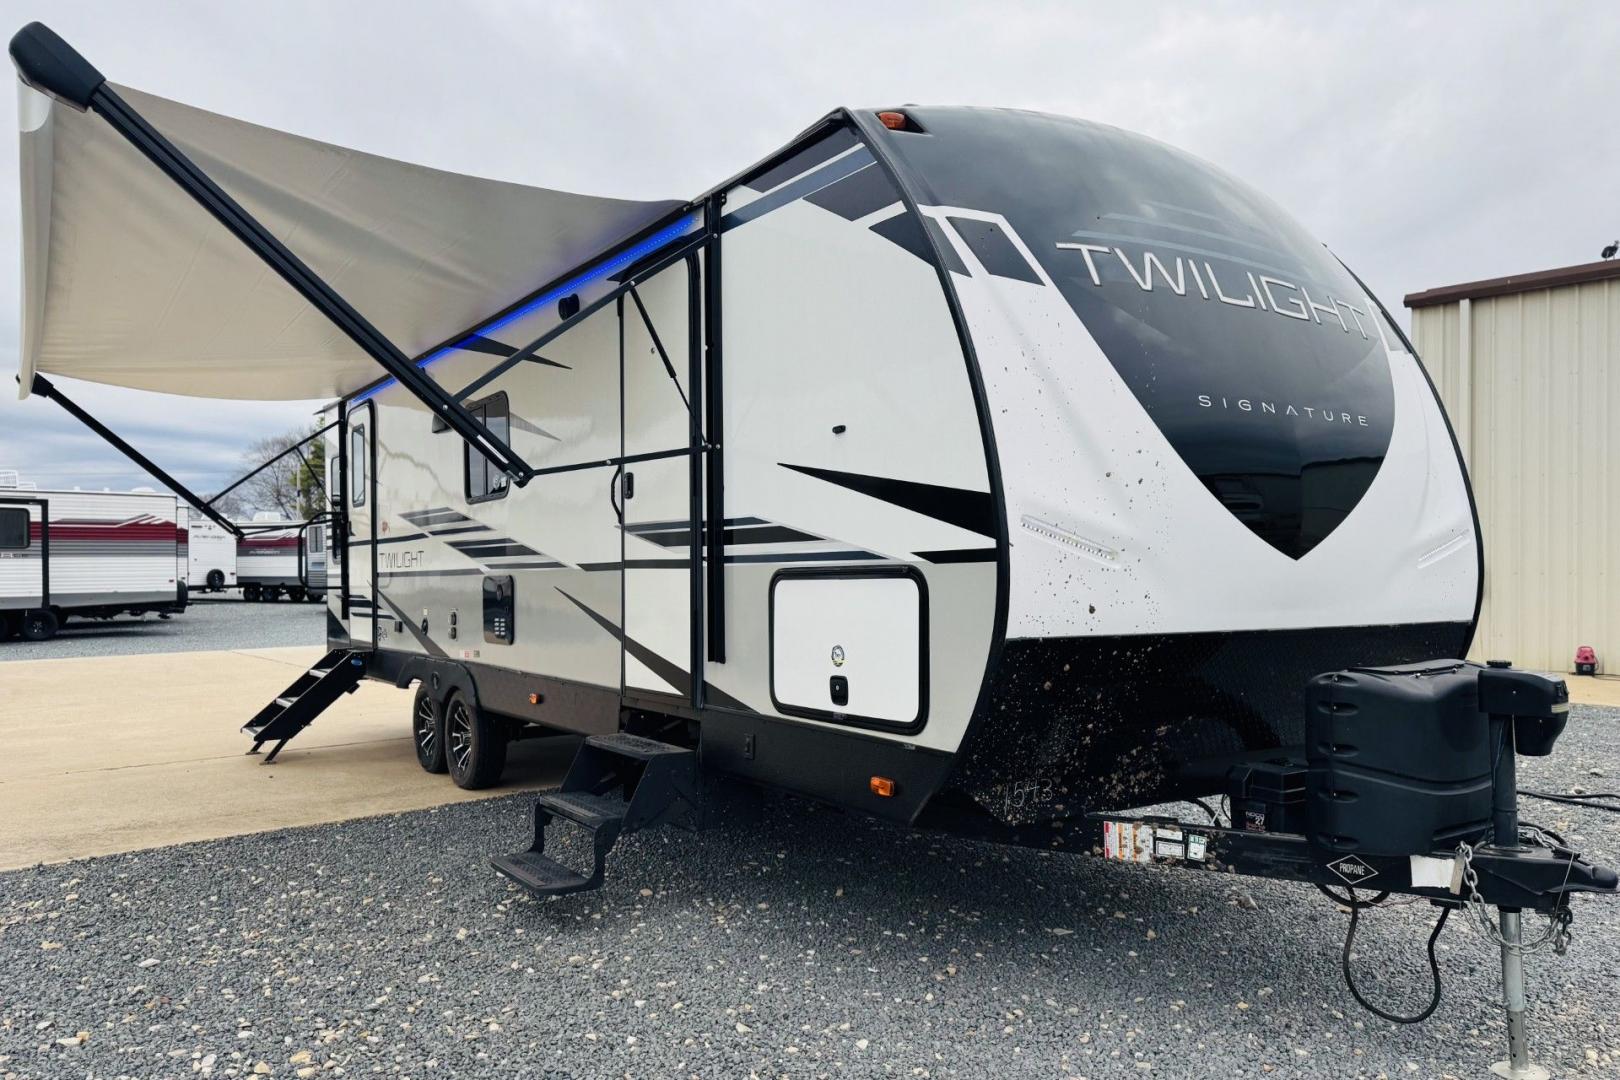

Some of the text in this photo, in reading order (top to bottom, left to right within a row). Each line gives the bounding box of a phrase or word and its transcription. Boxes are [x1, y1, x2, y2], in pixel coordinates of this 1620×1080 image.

[1056, 242, 1368, 340] TWILIGHT
[1198, 395, 1368, 426] SIGNATURE
[379, 550, 425, 568] TWILIGHT
[1339, 862, 1366, 876] PROPANE
